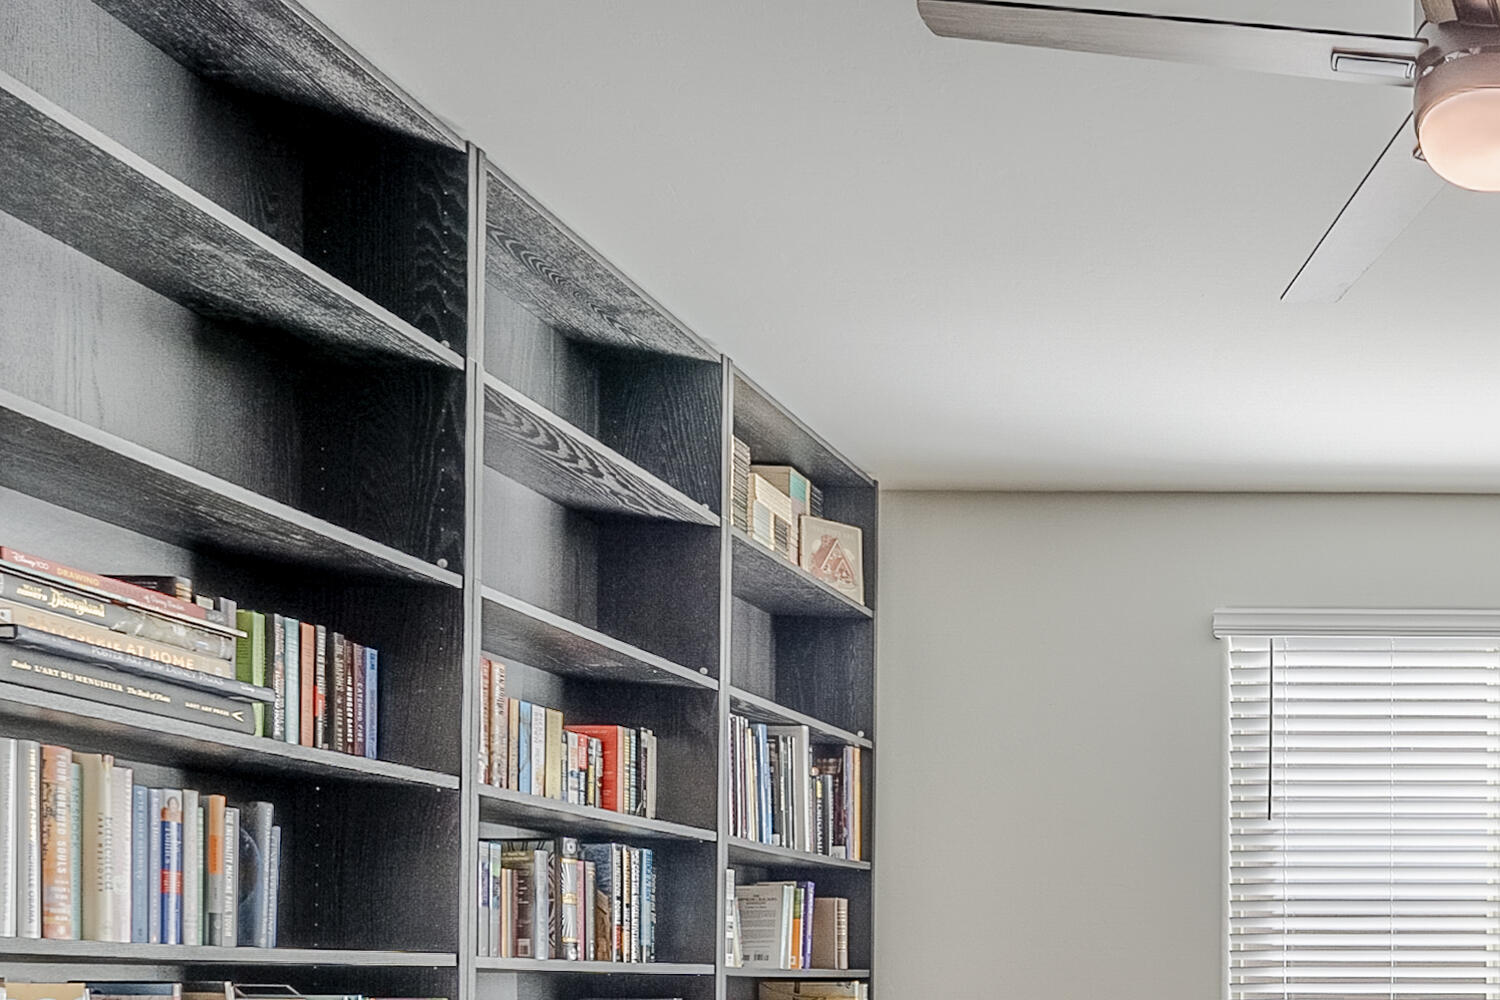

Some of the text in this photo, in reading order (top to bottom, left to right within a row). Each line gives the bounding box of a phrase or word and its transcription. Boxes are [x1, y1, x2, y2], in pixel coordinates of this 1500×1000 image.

[150, 649, 195, 668] HOME
[60, 671, 74, 681] DU
[56, 754, 68, 874] FOUR HUNDRED SOULS
[104, 816, 113, 891] Educated
[225, 824, 233, 862] INEQUALITY
[225, 862, 233, 894] MACHINE
[225, 894, 233, 913] PAUL
